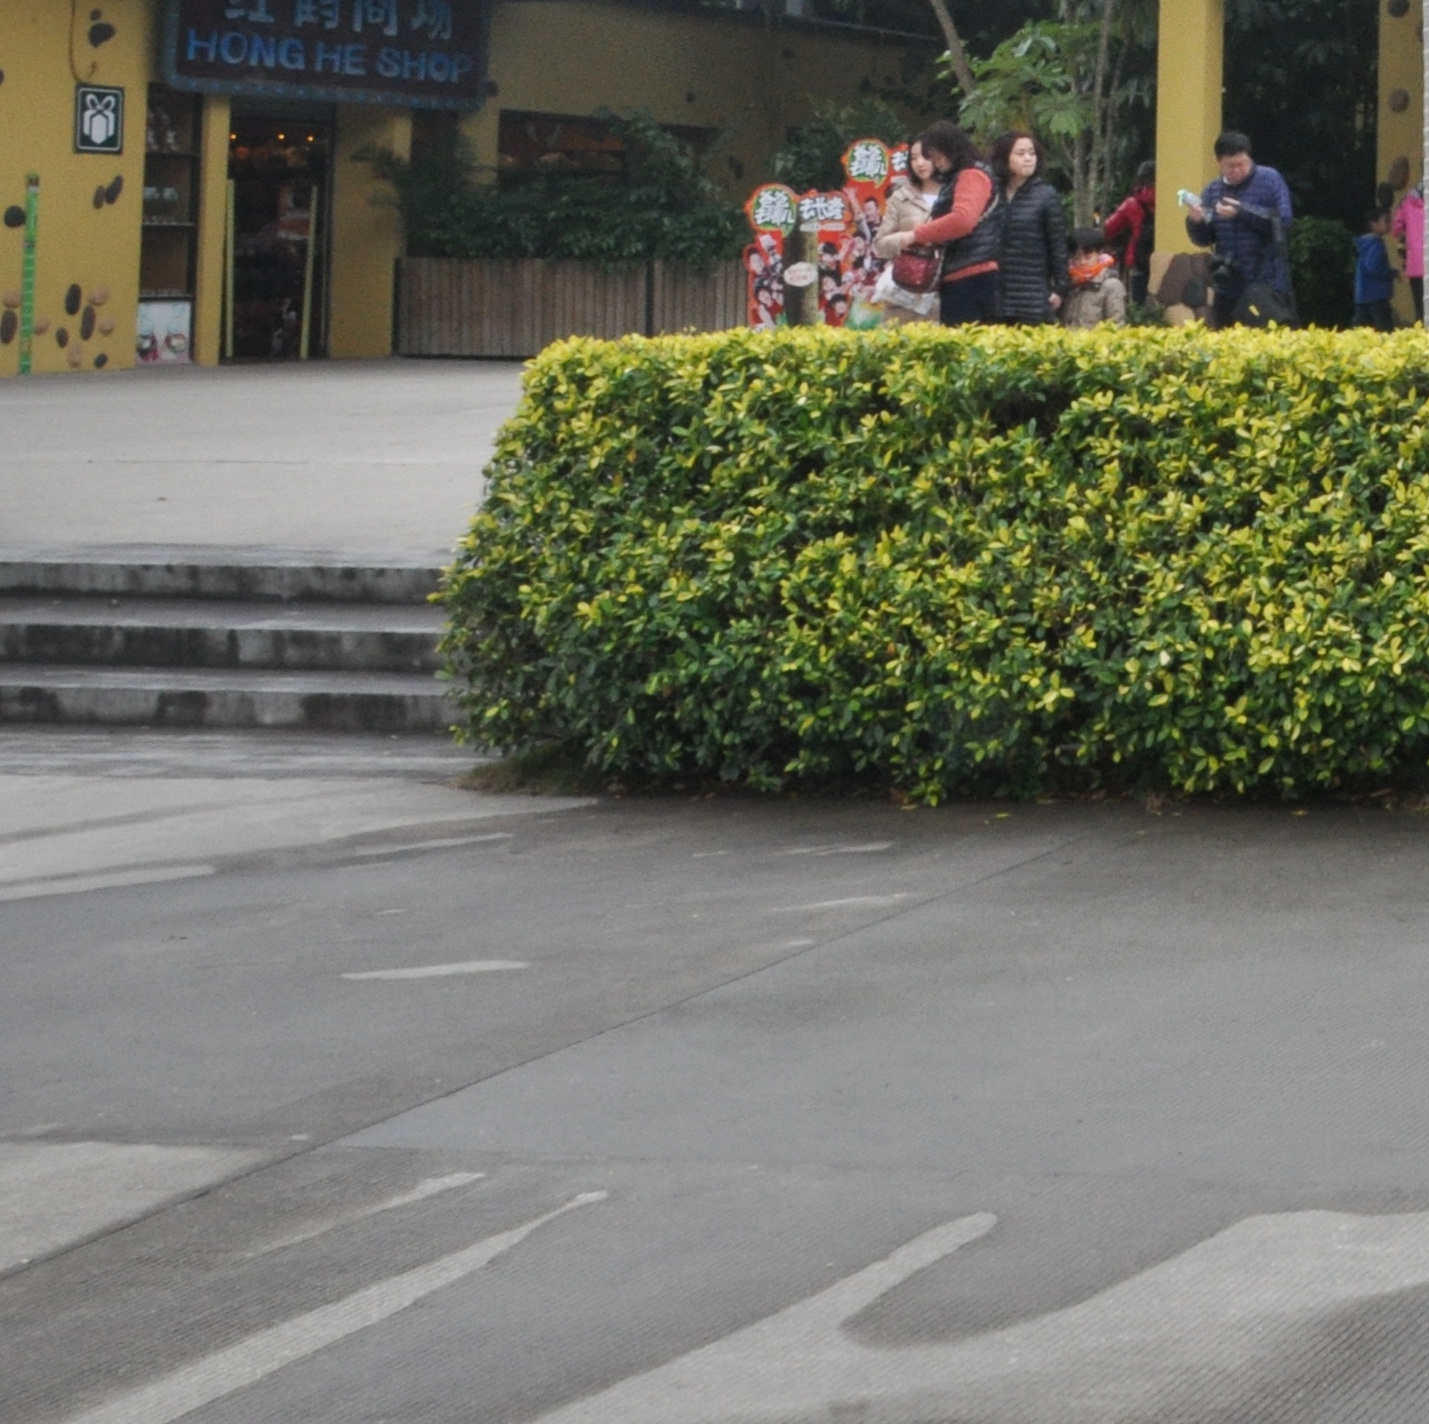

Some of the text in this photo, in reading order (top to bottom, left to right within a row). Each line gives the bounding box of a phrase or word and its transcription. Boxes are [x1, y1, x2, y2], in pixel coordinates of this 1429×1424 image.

[185, 28, 473, 84] HONG HE SHOP
